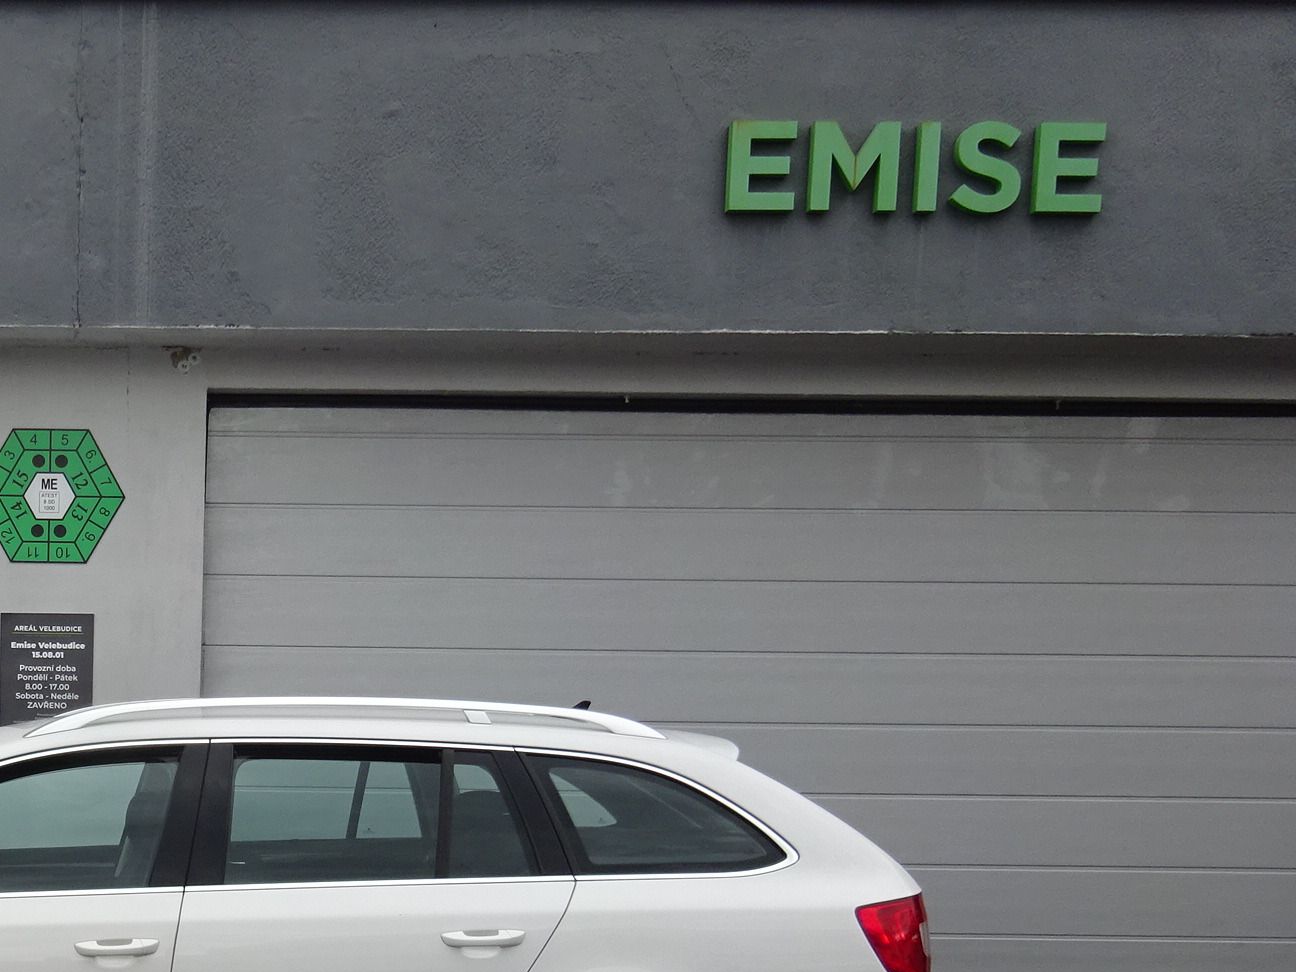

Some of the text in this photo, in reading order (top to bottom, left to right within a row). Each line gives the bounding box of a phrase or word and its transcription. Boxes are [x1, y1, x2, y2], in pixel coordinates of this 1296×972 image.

[724, 119, 1108, 215] EMISE
[29, 434, 38, 446] 4
[61, 434, 69, 446] 5
[3, 450, 16, 460] 3
[12, 470, 29, 488] 15
[41, 478, 58, 490] ME
[71, 471, 89, 490] 12
[10, 500, 28, 519] 14
[71, 503, 88, 521] 13
[99, 506, 111, 517] 8
[0, 528, 16, 544] 12
[55, 546, 71, 559] 10
[14, 624, 82, 633] AREÁL VELEBUDICE
[10, 640, 86, 650] Emise Velebudice
[31, 651, 65, 659] 15.08.01
[19, 664, 77, 672] Provozní doba
[17, 673, 49, 681] Pondělí
[54, 673, 79, 682] Pátek
[24, 683, 43, 691] 8.00
[49, 683, 70, 691] 17.00
[15, 692, 44, 700] Sobota
[50, 692, 80, 700] Neděle
[26, 701, 68, 709] ZAVŘENO
